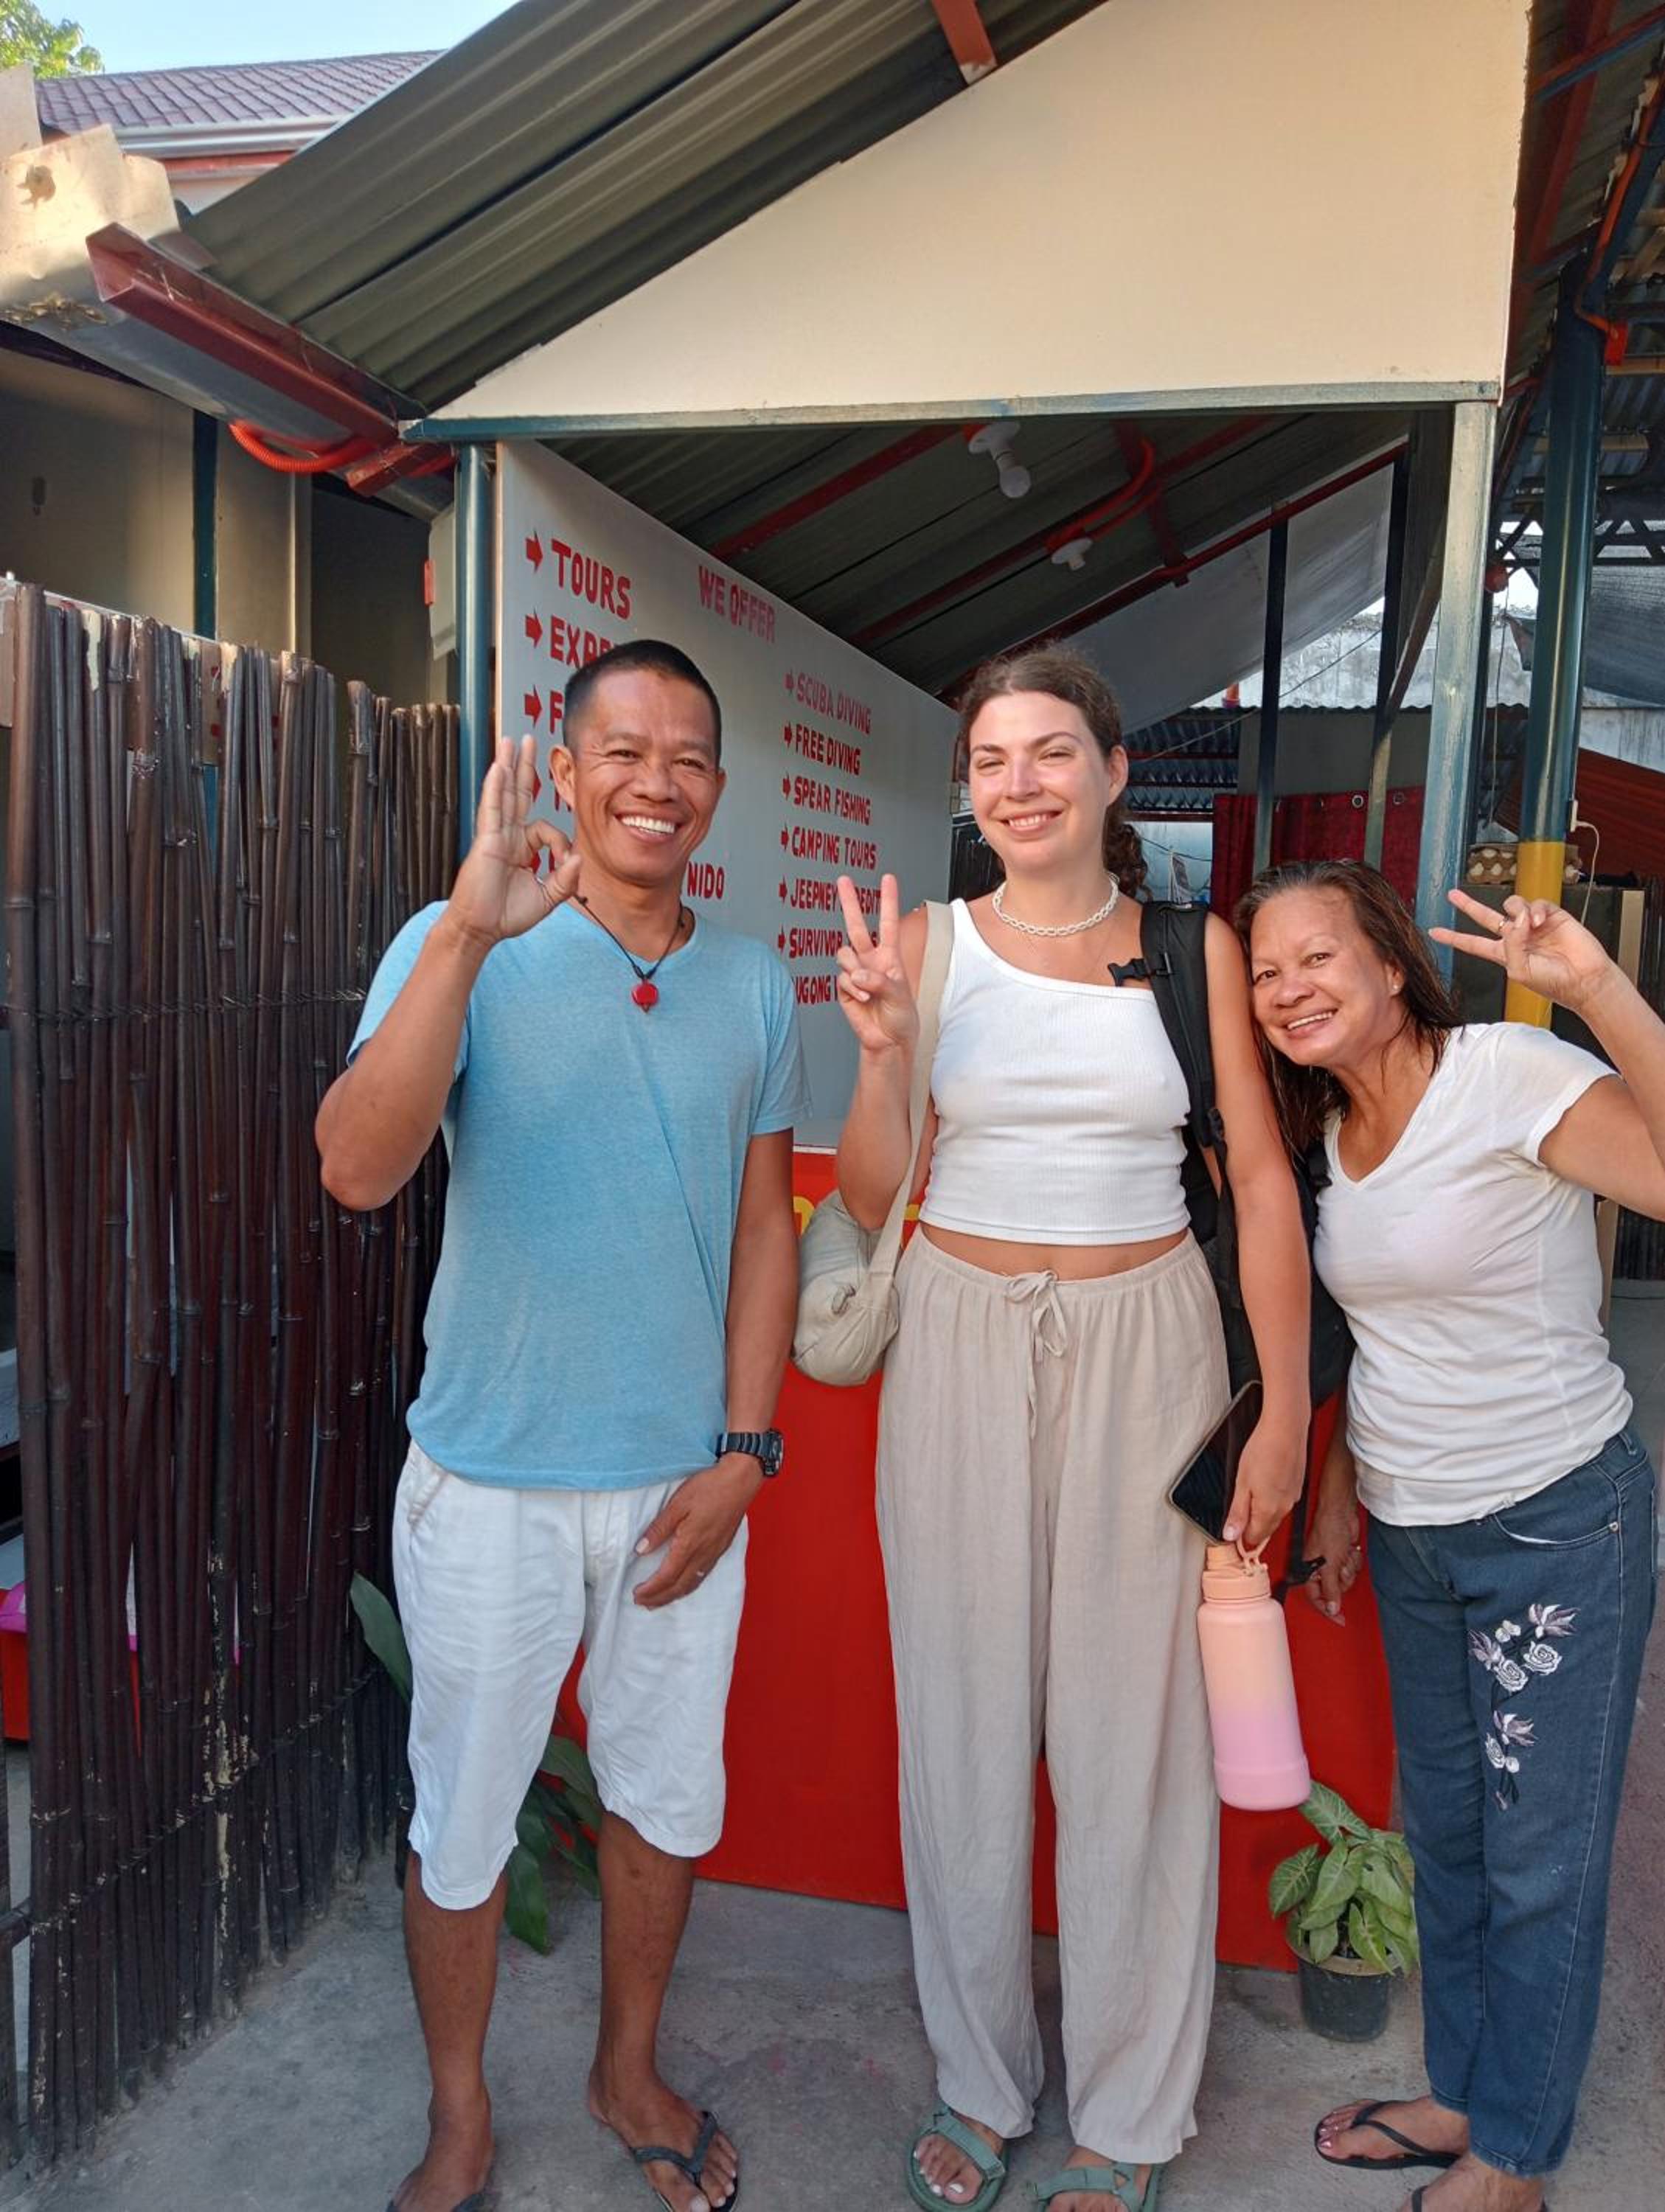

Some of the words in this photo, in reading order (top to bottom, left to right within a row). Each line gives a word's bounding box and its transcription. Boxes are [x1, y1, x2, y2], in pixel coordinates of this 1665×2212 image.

[551, 538, 631, 619] TOURS
[698, 565, 726, 616] WE
[729, 583, 776, 644] OFFER
[796, 672, 834, 717] SCUBA
[837, 692, 872, 734] DIVING
[796, 723, 824, 762] FREE
[826, 737, 861, 776] DIVING
[793, 776, 831, 813] SPEAR
[835, 788, 871, 826] FISHING
[792, 826, 841, 865] CAMPING
[844, 837, 877, 871] TOURS
[686, 860, 726, 900] NIDO
[790, 878, 838, 912] JEEPNEY
[793, 974, 831, 1004] UGONG
